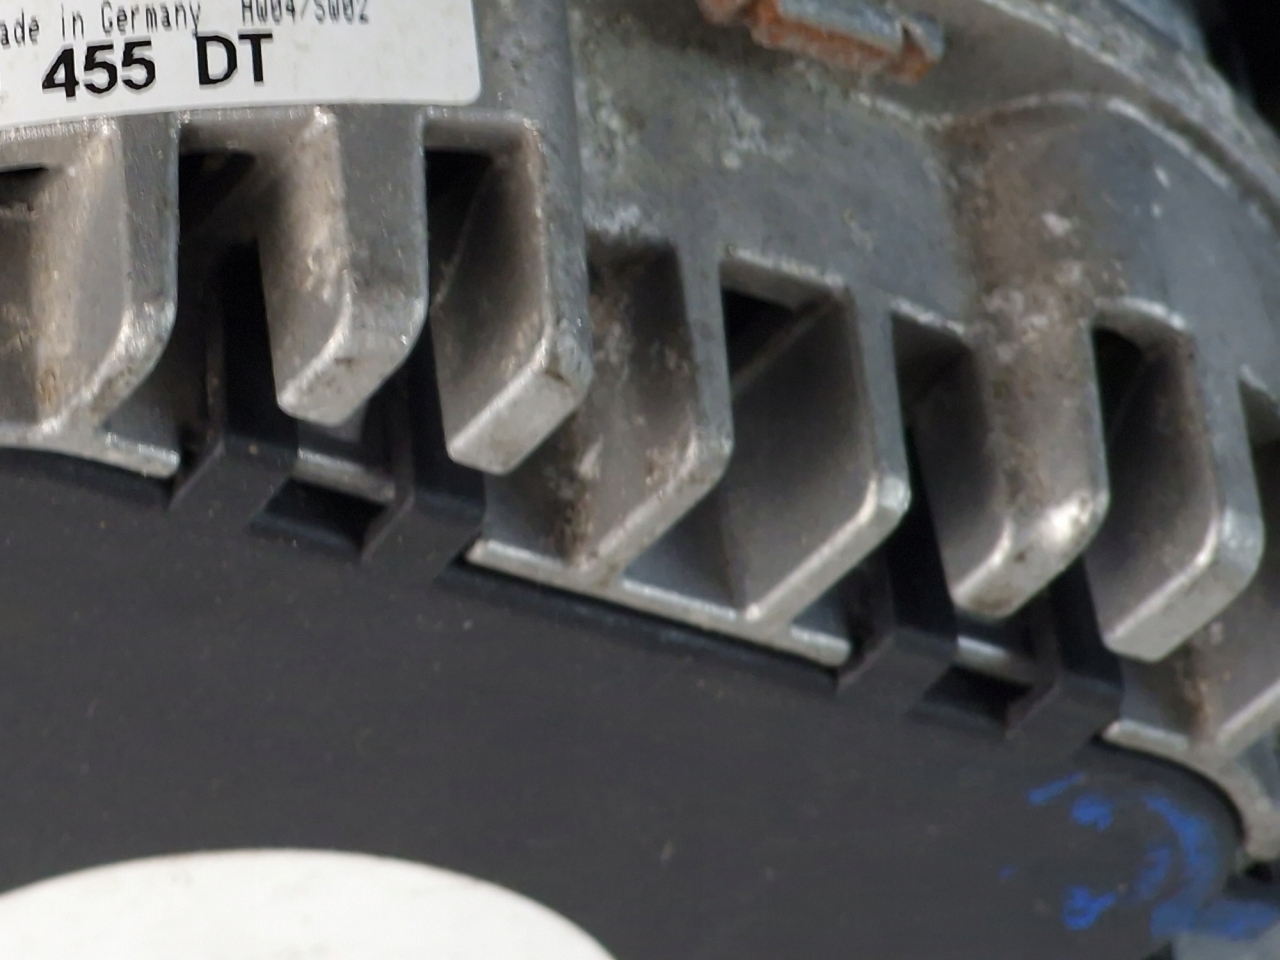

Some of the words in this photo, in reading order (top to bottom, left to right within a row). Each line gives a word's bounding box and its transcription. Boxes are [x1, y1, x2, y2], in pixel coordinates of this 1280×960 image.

[60, 2, 85, 42] in
[42, 38, 157, 98] 455
[195, 30, 274, 87] DT
